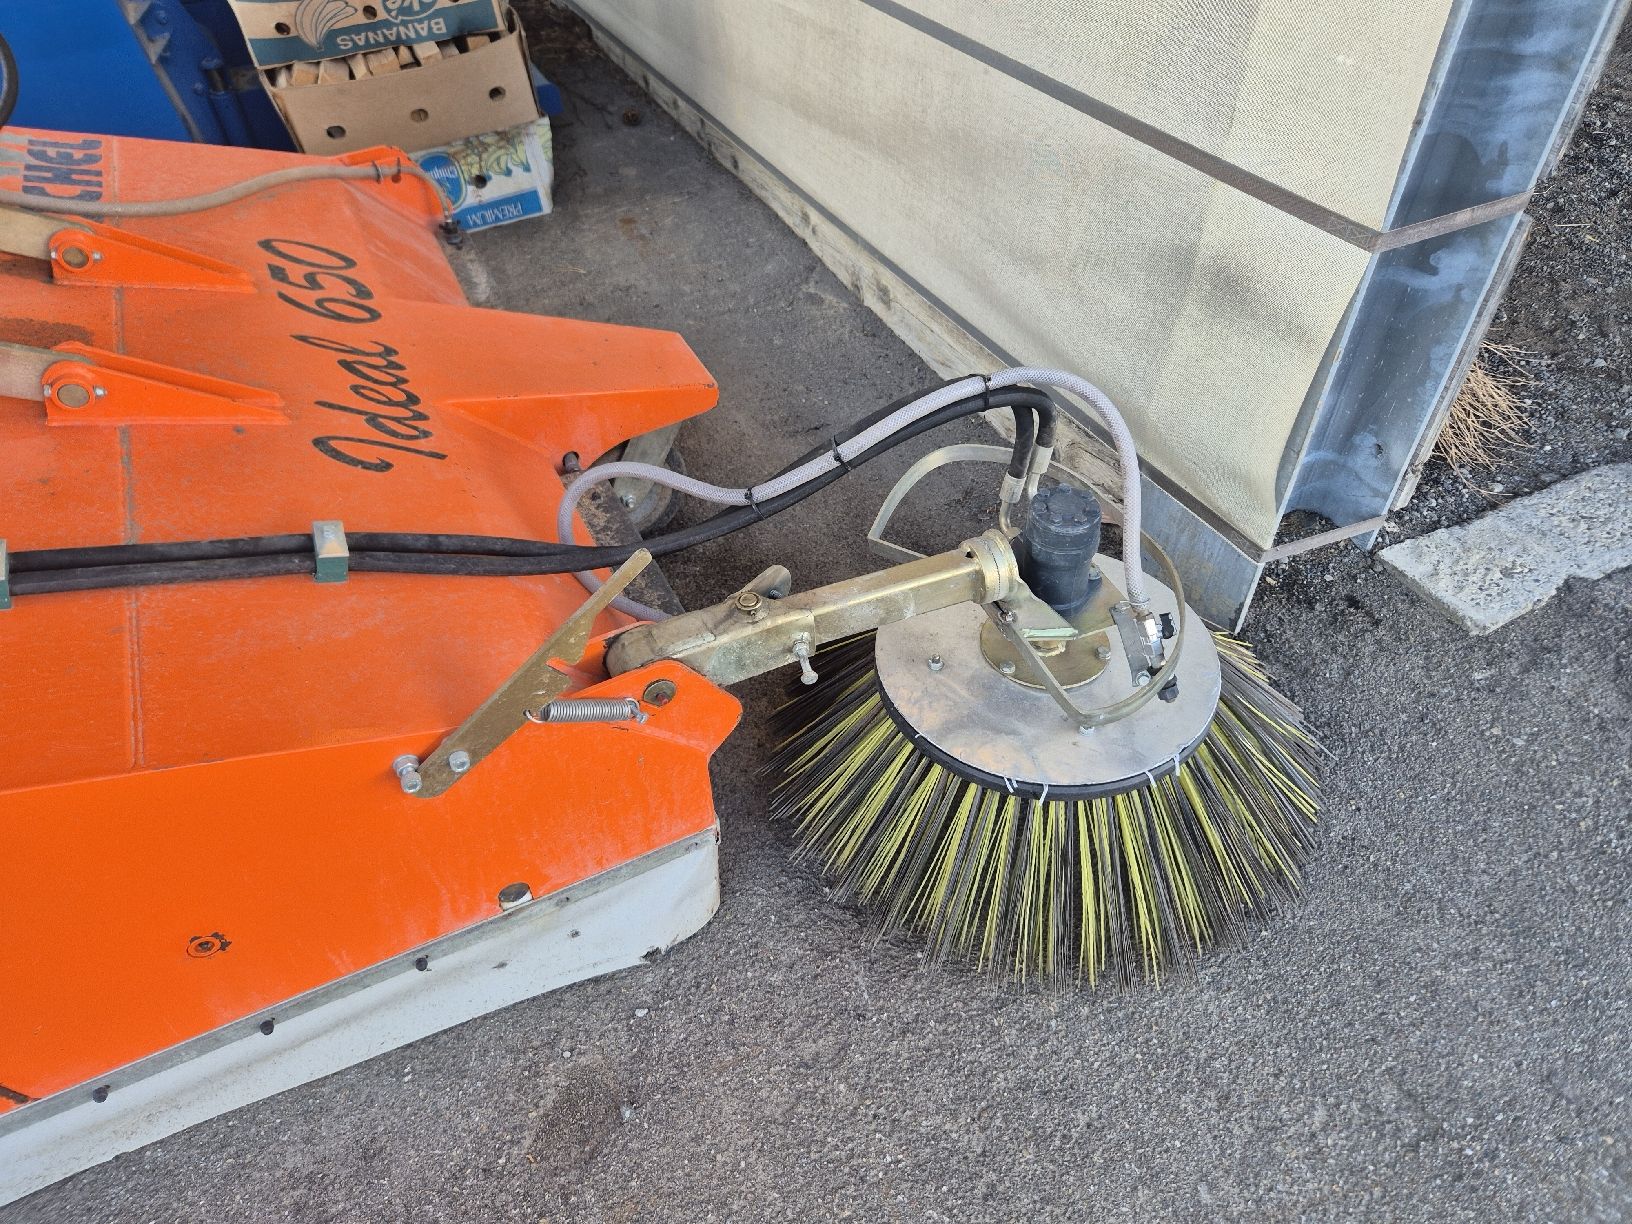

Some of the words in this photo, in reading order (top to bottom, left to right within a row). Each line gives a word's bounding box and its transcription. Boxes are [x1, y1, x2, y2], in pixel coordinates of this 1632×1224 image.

[336, 17, 447, 50] BANANAS
[467, 201, 523, 226] PREMIUM
[257, 238, 383, 324] 650
[289, 333, 449, 473] Ideal
